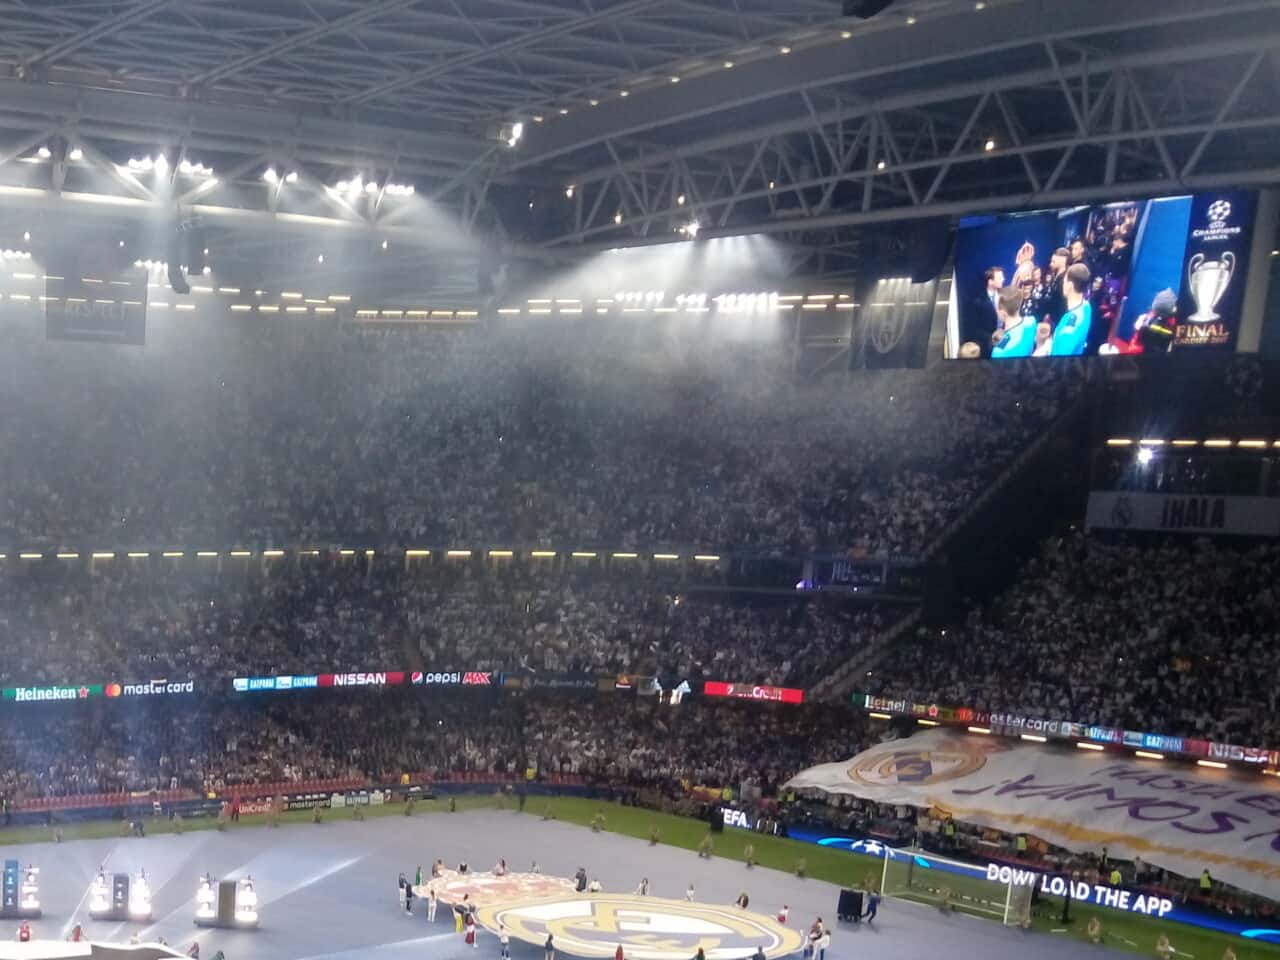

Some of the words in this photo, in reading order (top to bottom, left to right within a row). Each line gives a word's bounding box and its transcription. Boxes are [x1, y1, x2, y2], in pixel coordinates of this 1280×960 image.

[1192, 227, 1241, 238] CHAMPIONS
[1175, 323, 1230, 338] FINAL
[333, 672, 386, 686] NISSAN
[426, 671, 461, 686] pepsi
[15, 687, 76, 701] Heineken
[123, 680, 194, 696] mastercard
[1094, 885, 1130, 909] THE
[1132, 894, 1173, 917] APP
